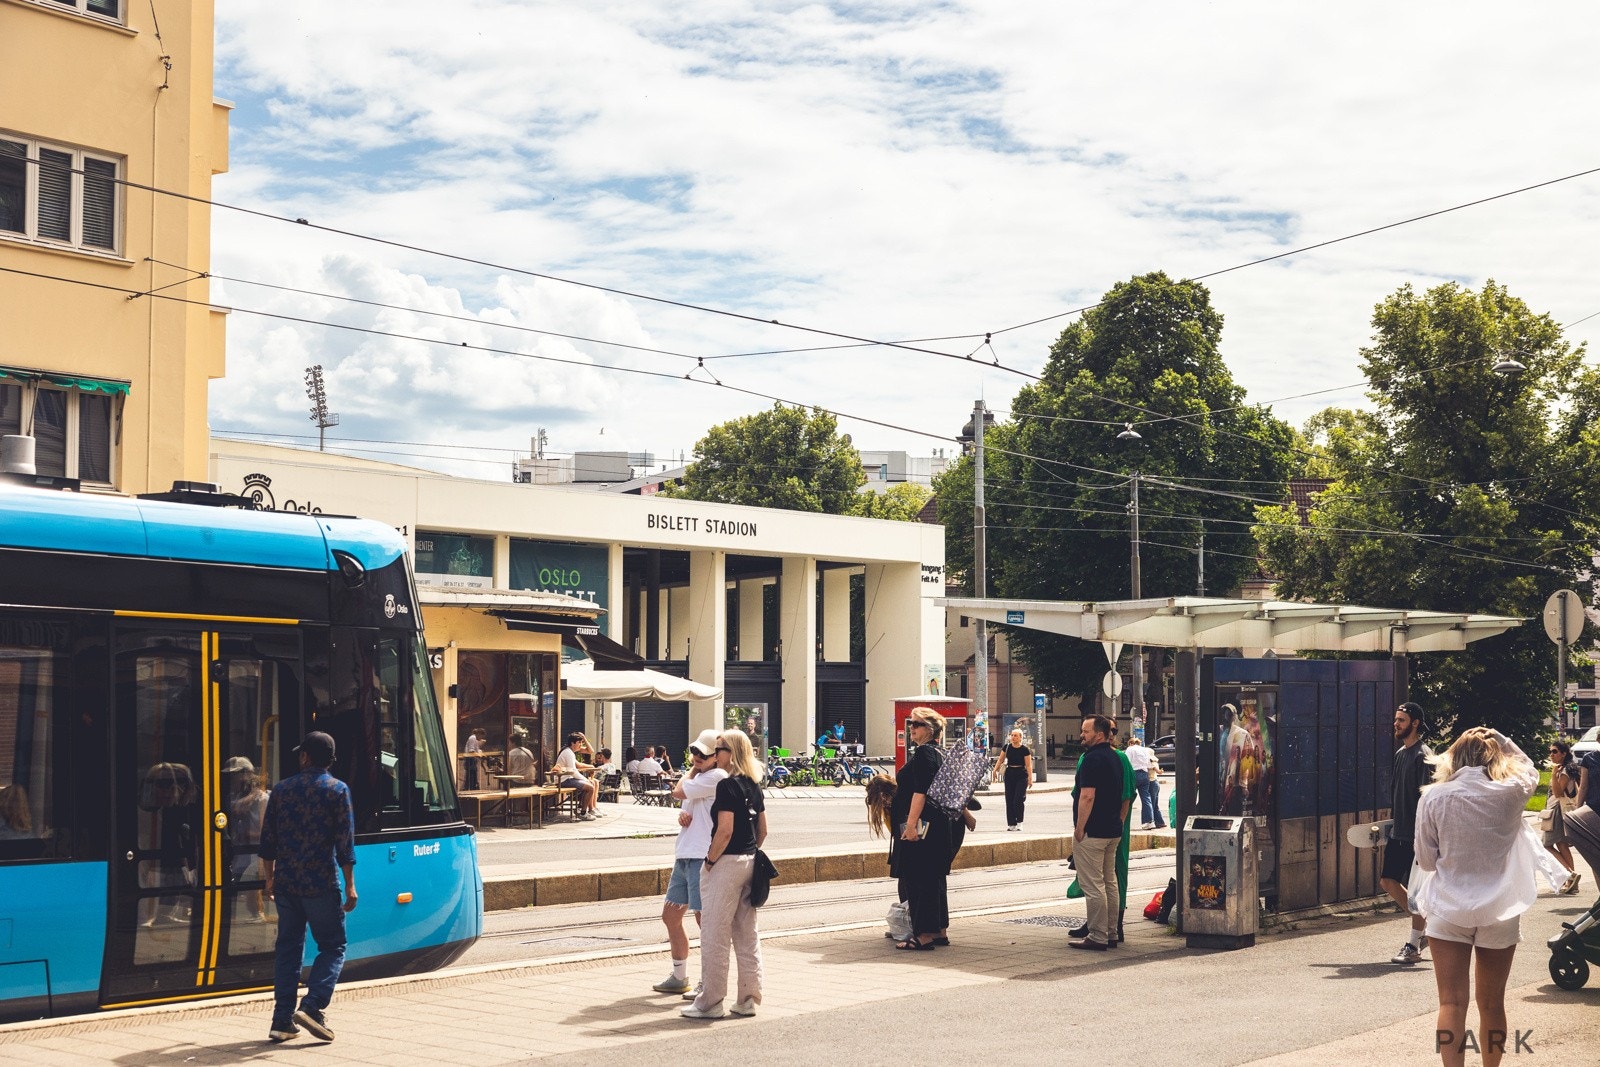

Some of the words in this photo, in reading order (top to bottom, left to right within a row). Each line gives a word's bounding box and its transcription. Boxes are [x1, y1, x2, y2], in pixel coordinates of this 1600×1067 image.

[647, 513, 699, 531] BISLETT
[705, 519, 757, 536] STADION
[540, 568, 581, 587] OSLO
[397, 604, 408, 614] Oslo
[576, 627, 598, 636] STARBUCKS
[413, 841, 440, 857] Ruter#
